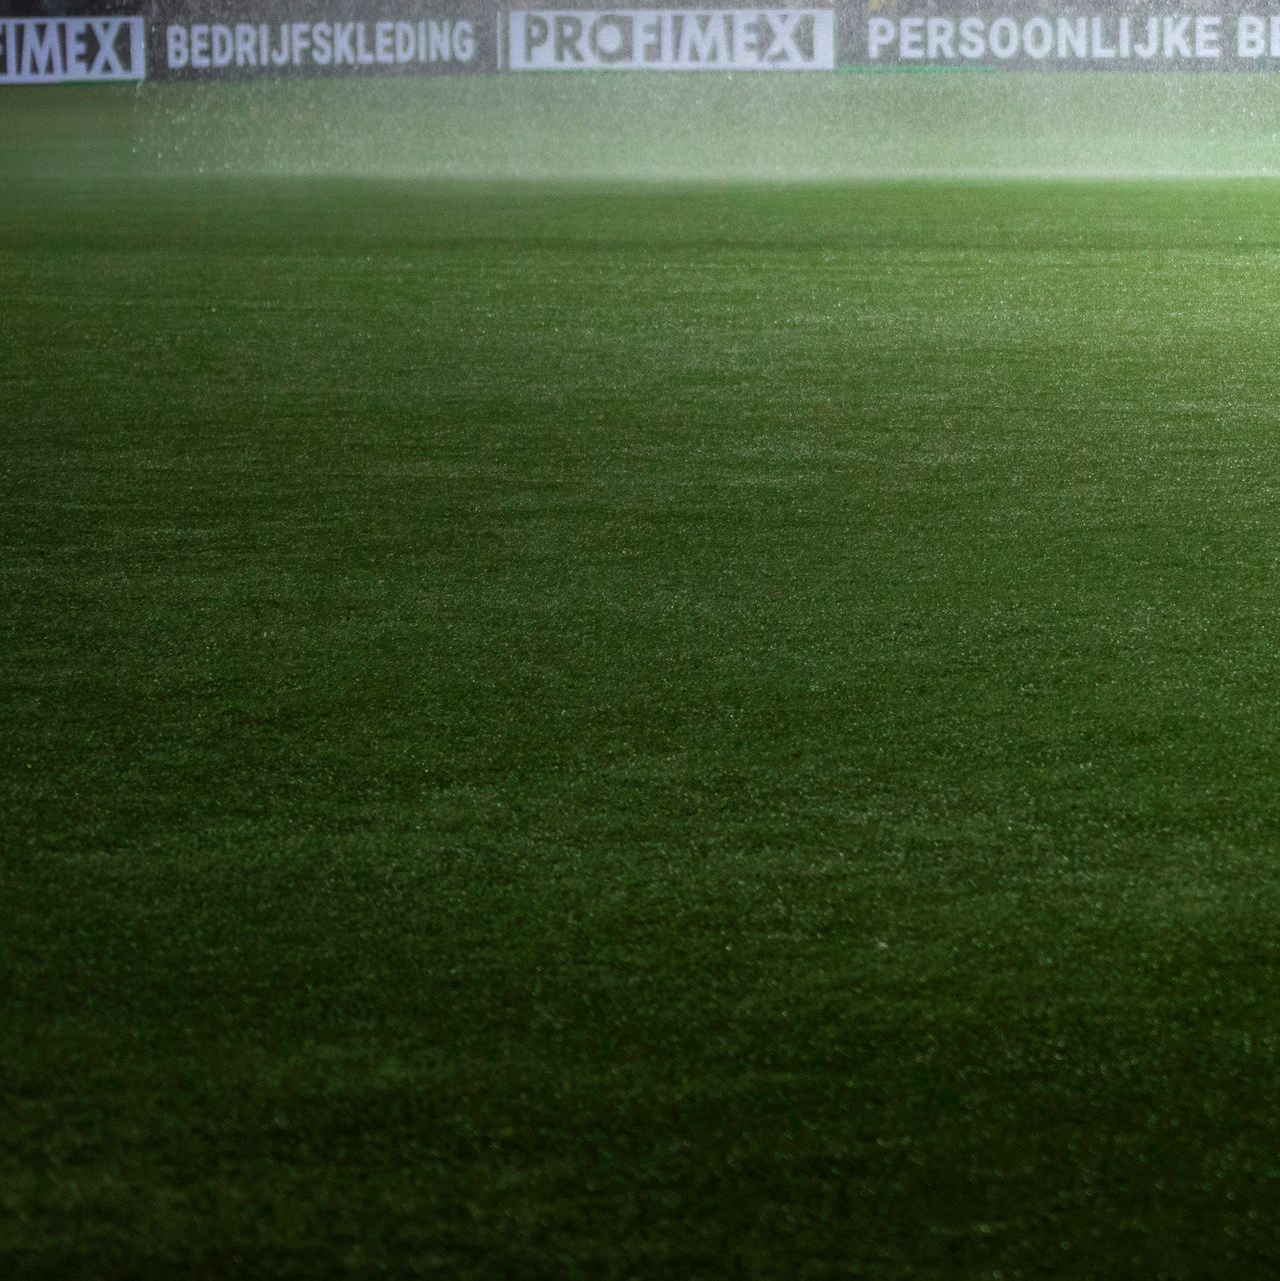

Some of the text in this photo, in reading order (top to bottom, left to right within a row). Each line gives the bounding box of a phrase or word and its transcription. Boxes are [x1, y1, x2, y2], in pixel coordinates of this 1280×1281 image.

[0, 22, 132, 74] IMEX
[166, 20, 476, 69] BEDRIJFSKLEDING
[522, 13, 816, 64] PROFIMEX
[868, 15, 1222, 60] PERSOONLIJKE
